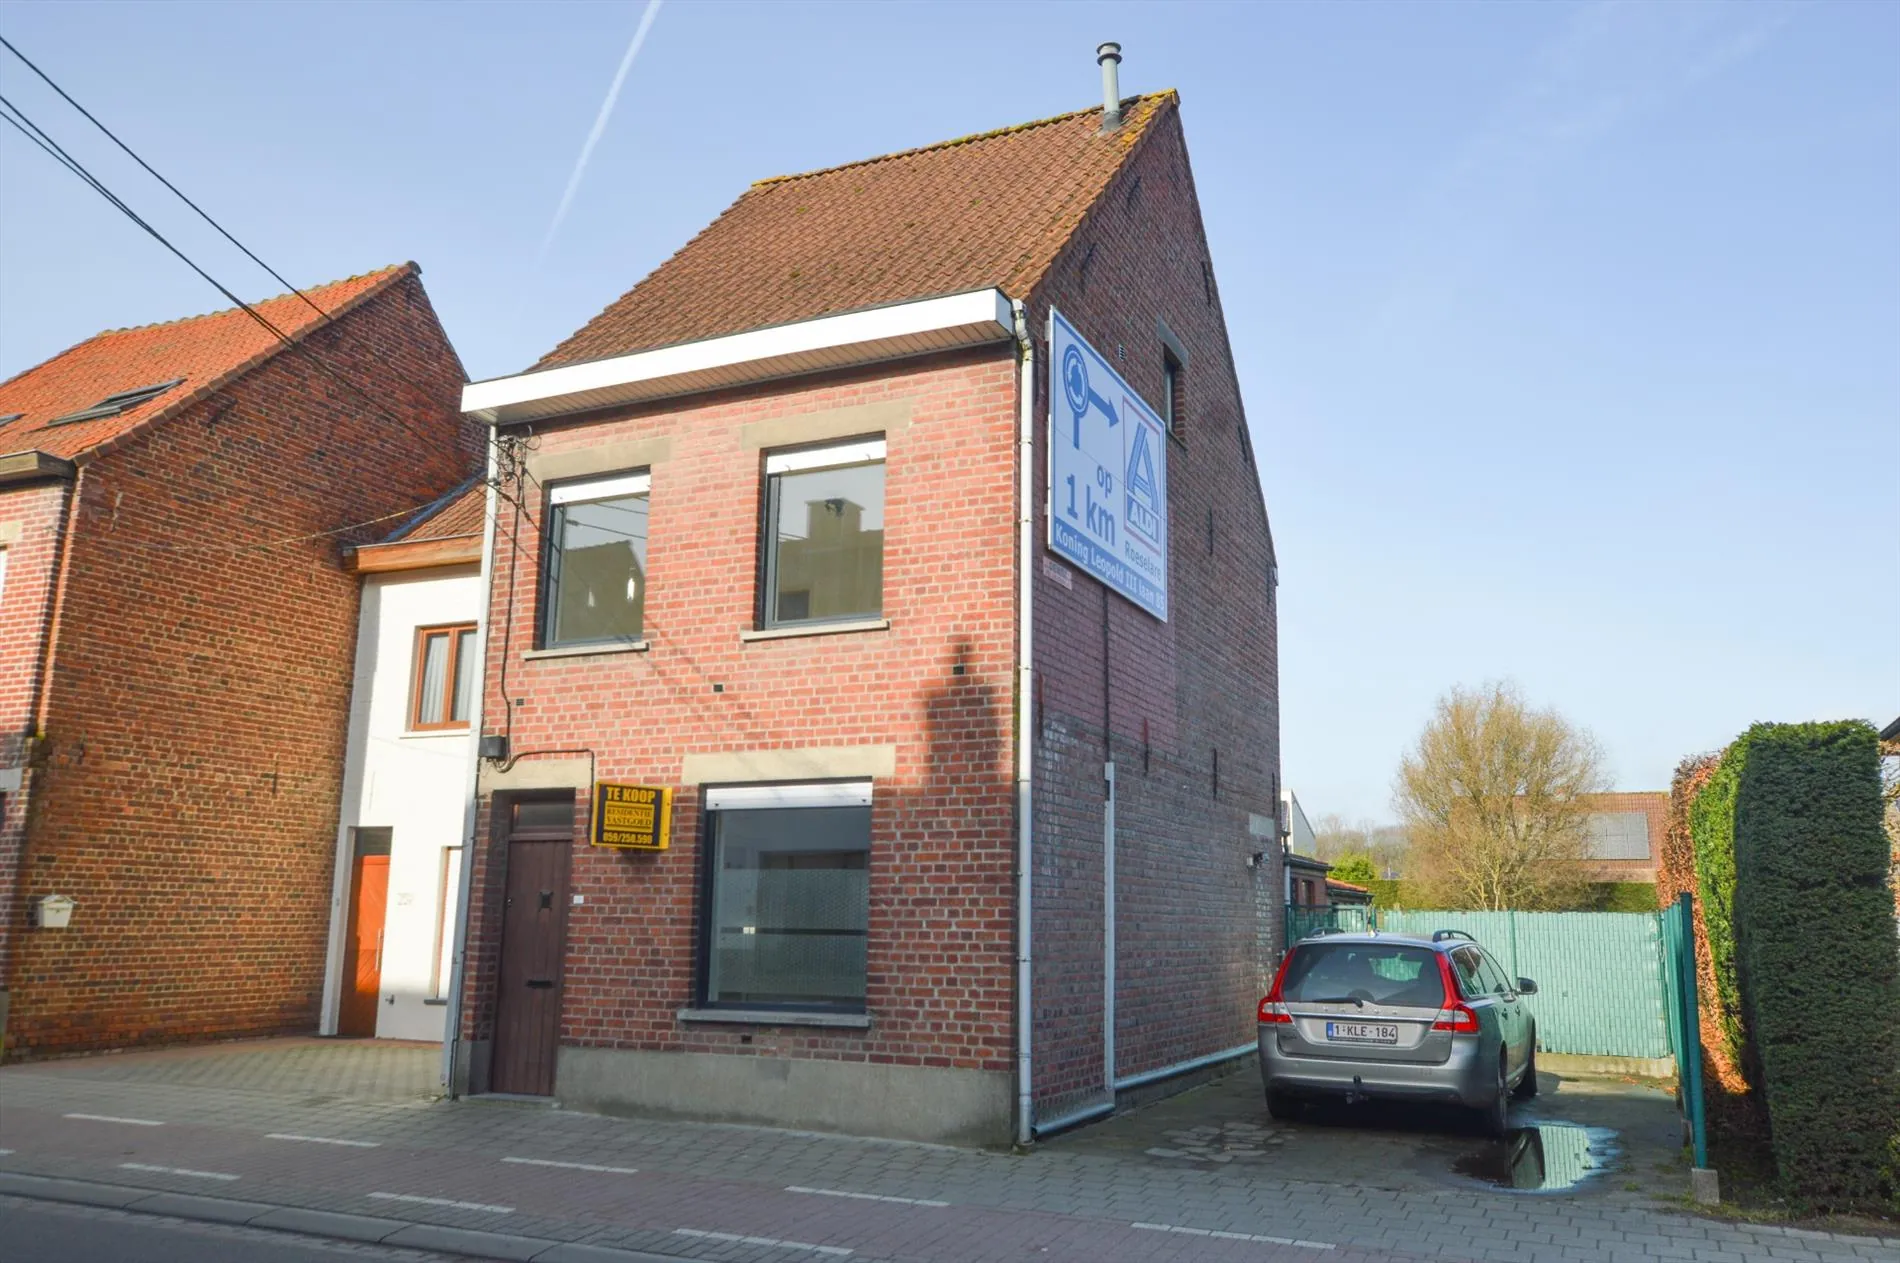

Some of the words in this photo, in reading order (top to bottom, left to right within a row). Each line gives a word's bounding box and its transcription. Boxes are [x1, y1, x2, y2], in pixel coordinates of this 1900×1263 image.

[1096, 465, 1113, 498] op
[1066, 473, 1079, 521] 1
[1086, 484, 1116, 547] km
[1129, 499, 1157, 543] ALDI
[1055, 523, 1088, 565] Koning
[1091, 545, 1124, 584] Leopold
[1125, 571, 1137, 594] III
[1139, 580, 1154, 606] laan
[1125, 540, 1162, 582] Roeselare
[606, 787, 620, 800] TE
[622, 788, 656, 803] KOOP
[607, 815, 652, 826] VASTGOED
